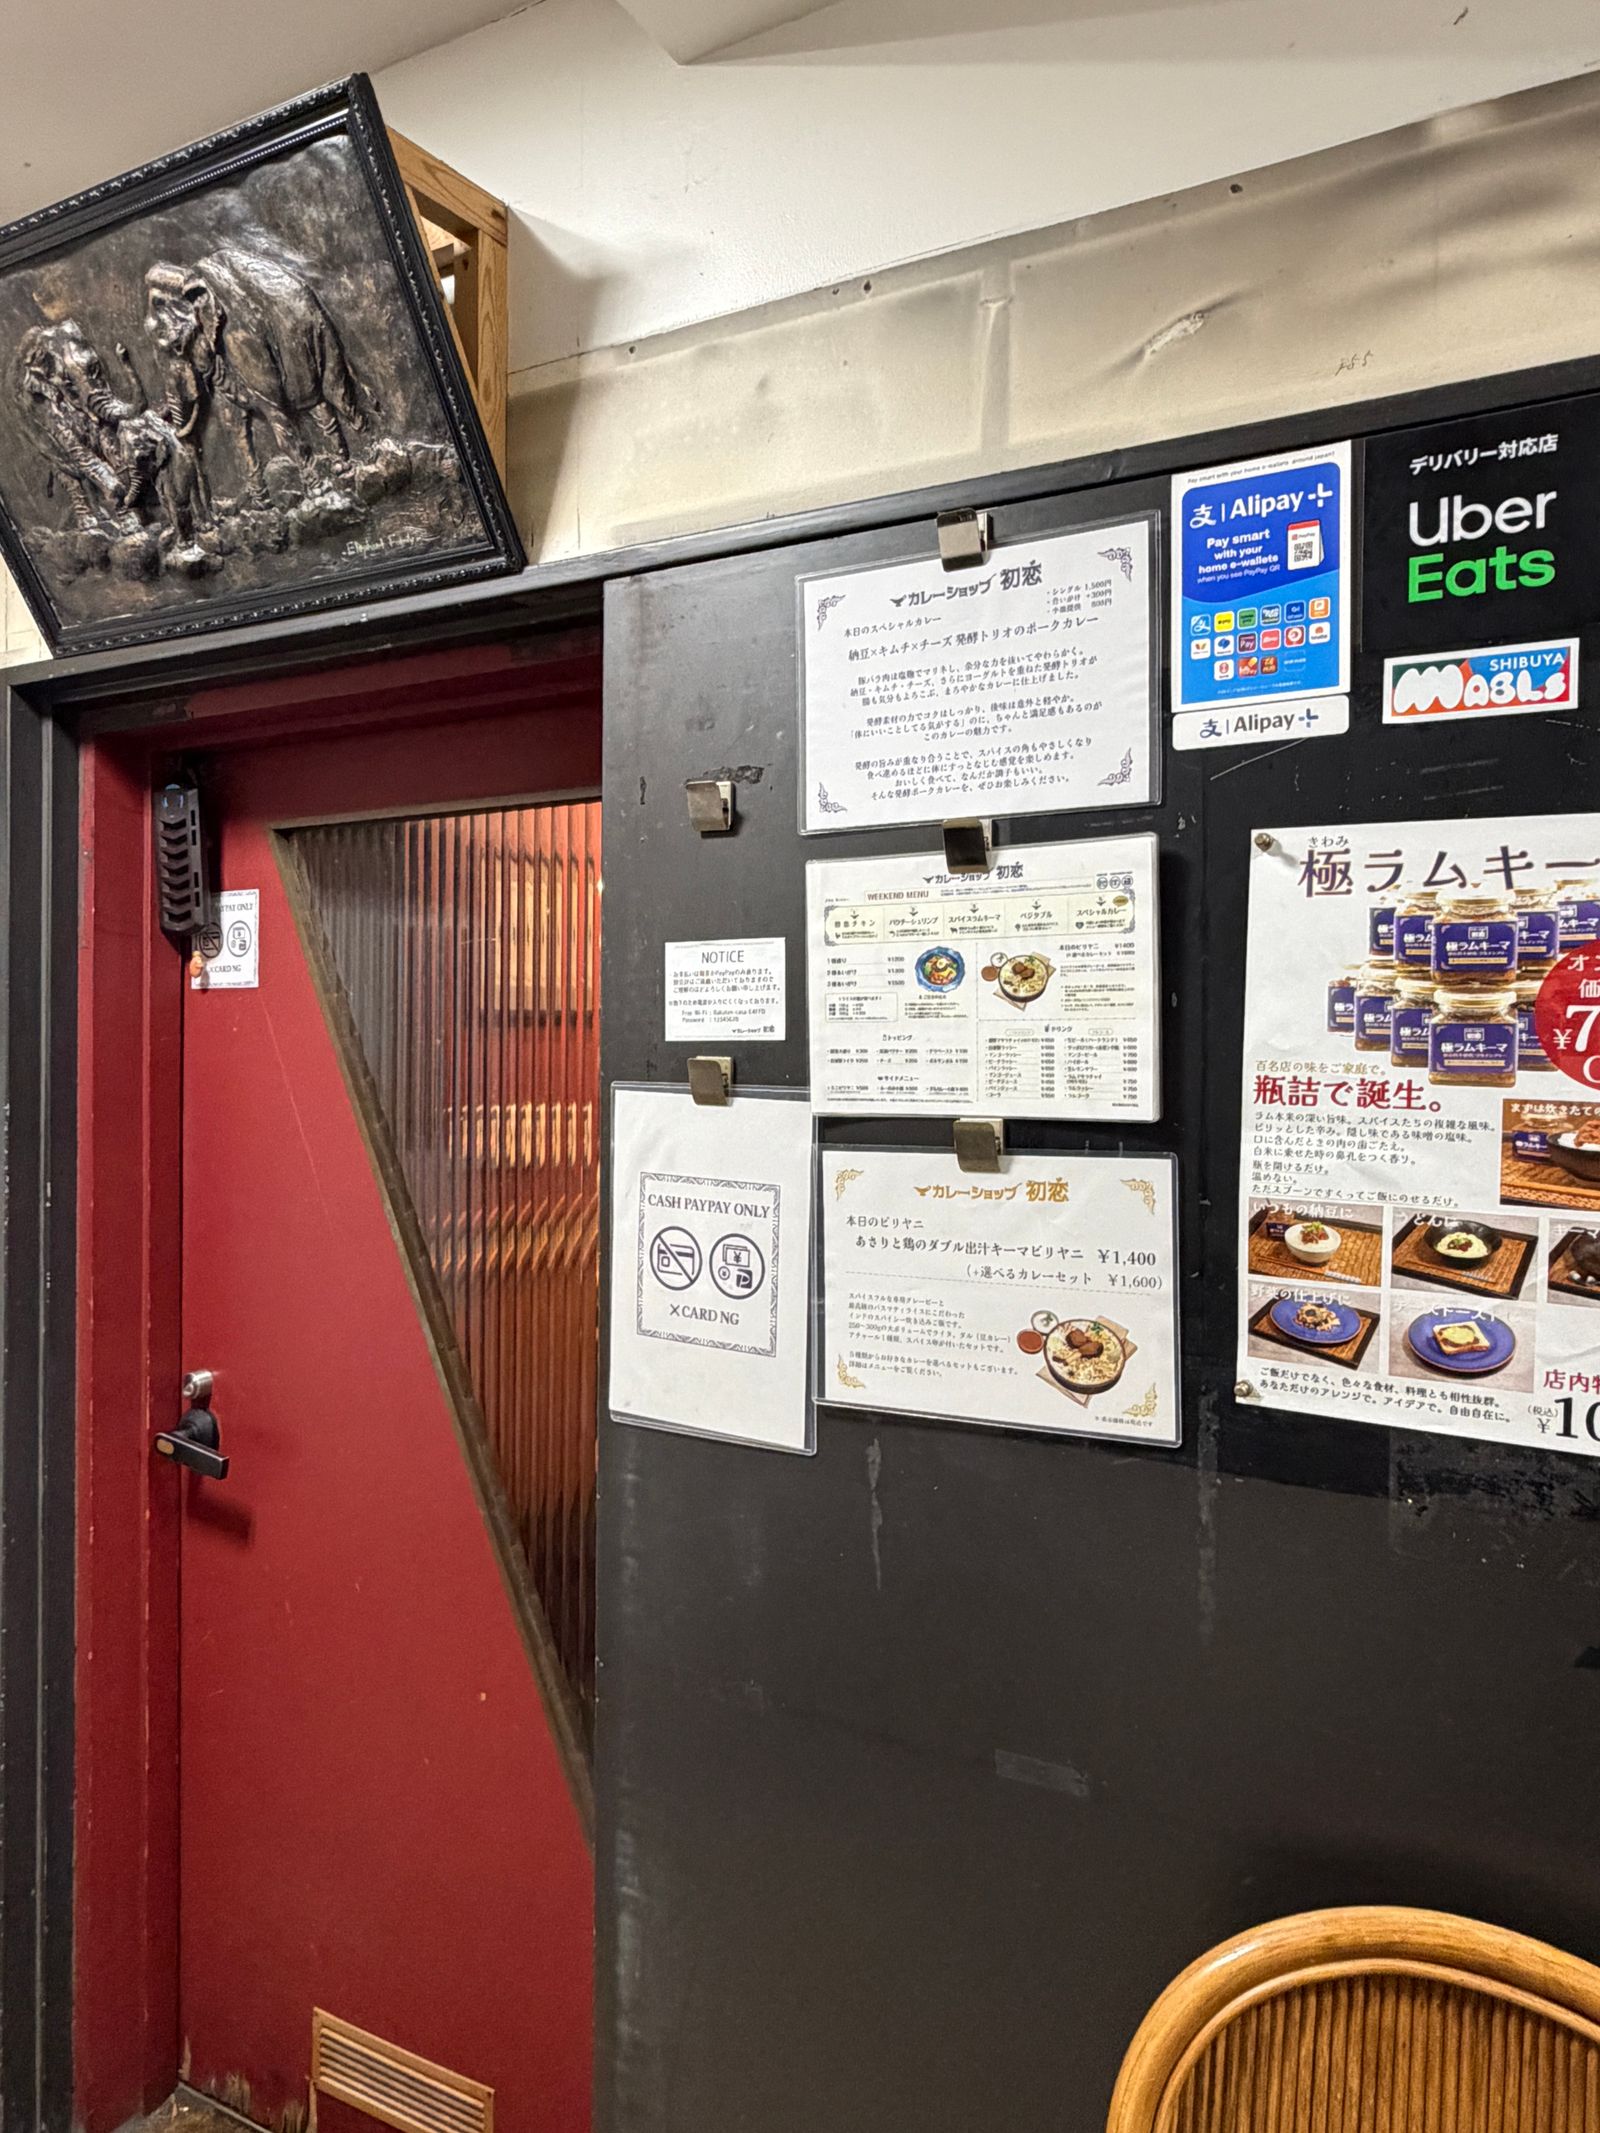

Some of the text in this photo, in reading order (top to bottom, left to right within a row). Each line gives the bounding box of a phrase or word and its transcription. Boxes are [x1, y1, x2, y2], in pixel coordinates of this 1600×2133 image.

[1409, 434, 1559, 476] デリバリー対応店
[1408, 491, 1558, 547] Uber
[1206, 528, 1270, 549] Pay smart
[1214, 545, 1263, 560] with your
[1198, 553, 1279, 574] home e-wallets
[908, 559, 1042, 606] カレーショップ 初恋
[1197, 564, 1281, 584] when you see PayPay QR
[1408, 546, 1556, 603] Eats
[844, 615, 942, 638] 本日のスペシャルカレー
[848, 615, 1099, 661] 納豆×キムチ×チーズ 発酵トリオのポークカレー
[1489, 652, 1565, 672] SHIBUYA
[924, 725, 1012, 741] このカレーの魅力です。
[1308, 836, 1349, 848] きわみ
[996, 861, 1024, 880] 初恋
[1298, 845, 1600, 898] 極ラムキー
[867, 890, 929, 901] WEEKEND MENU
[1445, 941, 1511, 952] 極ラムキーマ
[701, 950, 745, 964] NOTICE
[1440, 1042, 1508, 1053] 極ラムキーマ
[1256, 1060, 1387, 1076] 百名店の味をご家庭で。
[1253, 1075, 1442, 1112] 瓶詰で誕生。
[1254, 1111, 1496, 1132] ラム本来の深い旨味。スパイスたちの複雑な風味。
[1253, 1135, 1406, 1153] 口に含んだときの肉の歯ごたえ。
[1252, 1160, 1330, 1175] 瓶を開けるだけ。
[1251, 1172, 1298, 1185] 温めない。
[932, 1177, 1070, 1203] カレーショップ 初恋
[1251, 1184, 1459, 1208] ただスプーンですくってご飯にのせるだけ。
[648, 1193, 771, 1219] CASH PAYPAY ONLY
[1253, 1202, 1354, 1219] いつもの納豆に
[846, 1215, 925, 1231] 本日のビリヤニ
[855, 1235, 1157, 1267] あさりと鶏のダブル出汁キーマビリヤニ ¥1,400
[1107, 1271, 1163, 1290] ¥1,600)
[720, 1311, 740, 1326] NG
[1260, 1367, 1501, 1410] ご飯だけでなく、色々な食材、料理とも相性抜群。
[1260, 1380, 1511, 1423] あなただけのアレンジで。アイデアで。自由自在に。
[1528, 1404, 1559, 1418] (税込)
